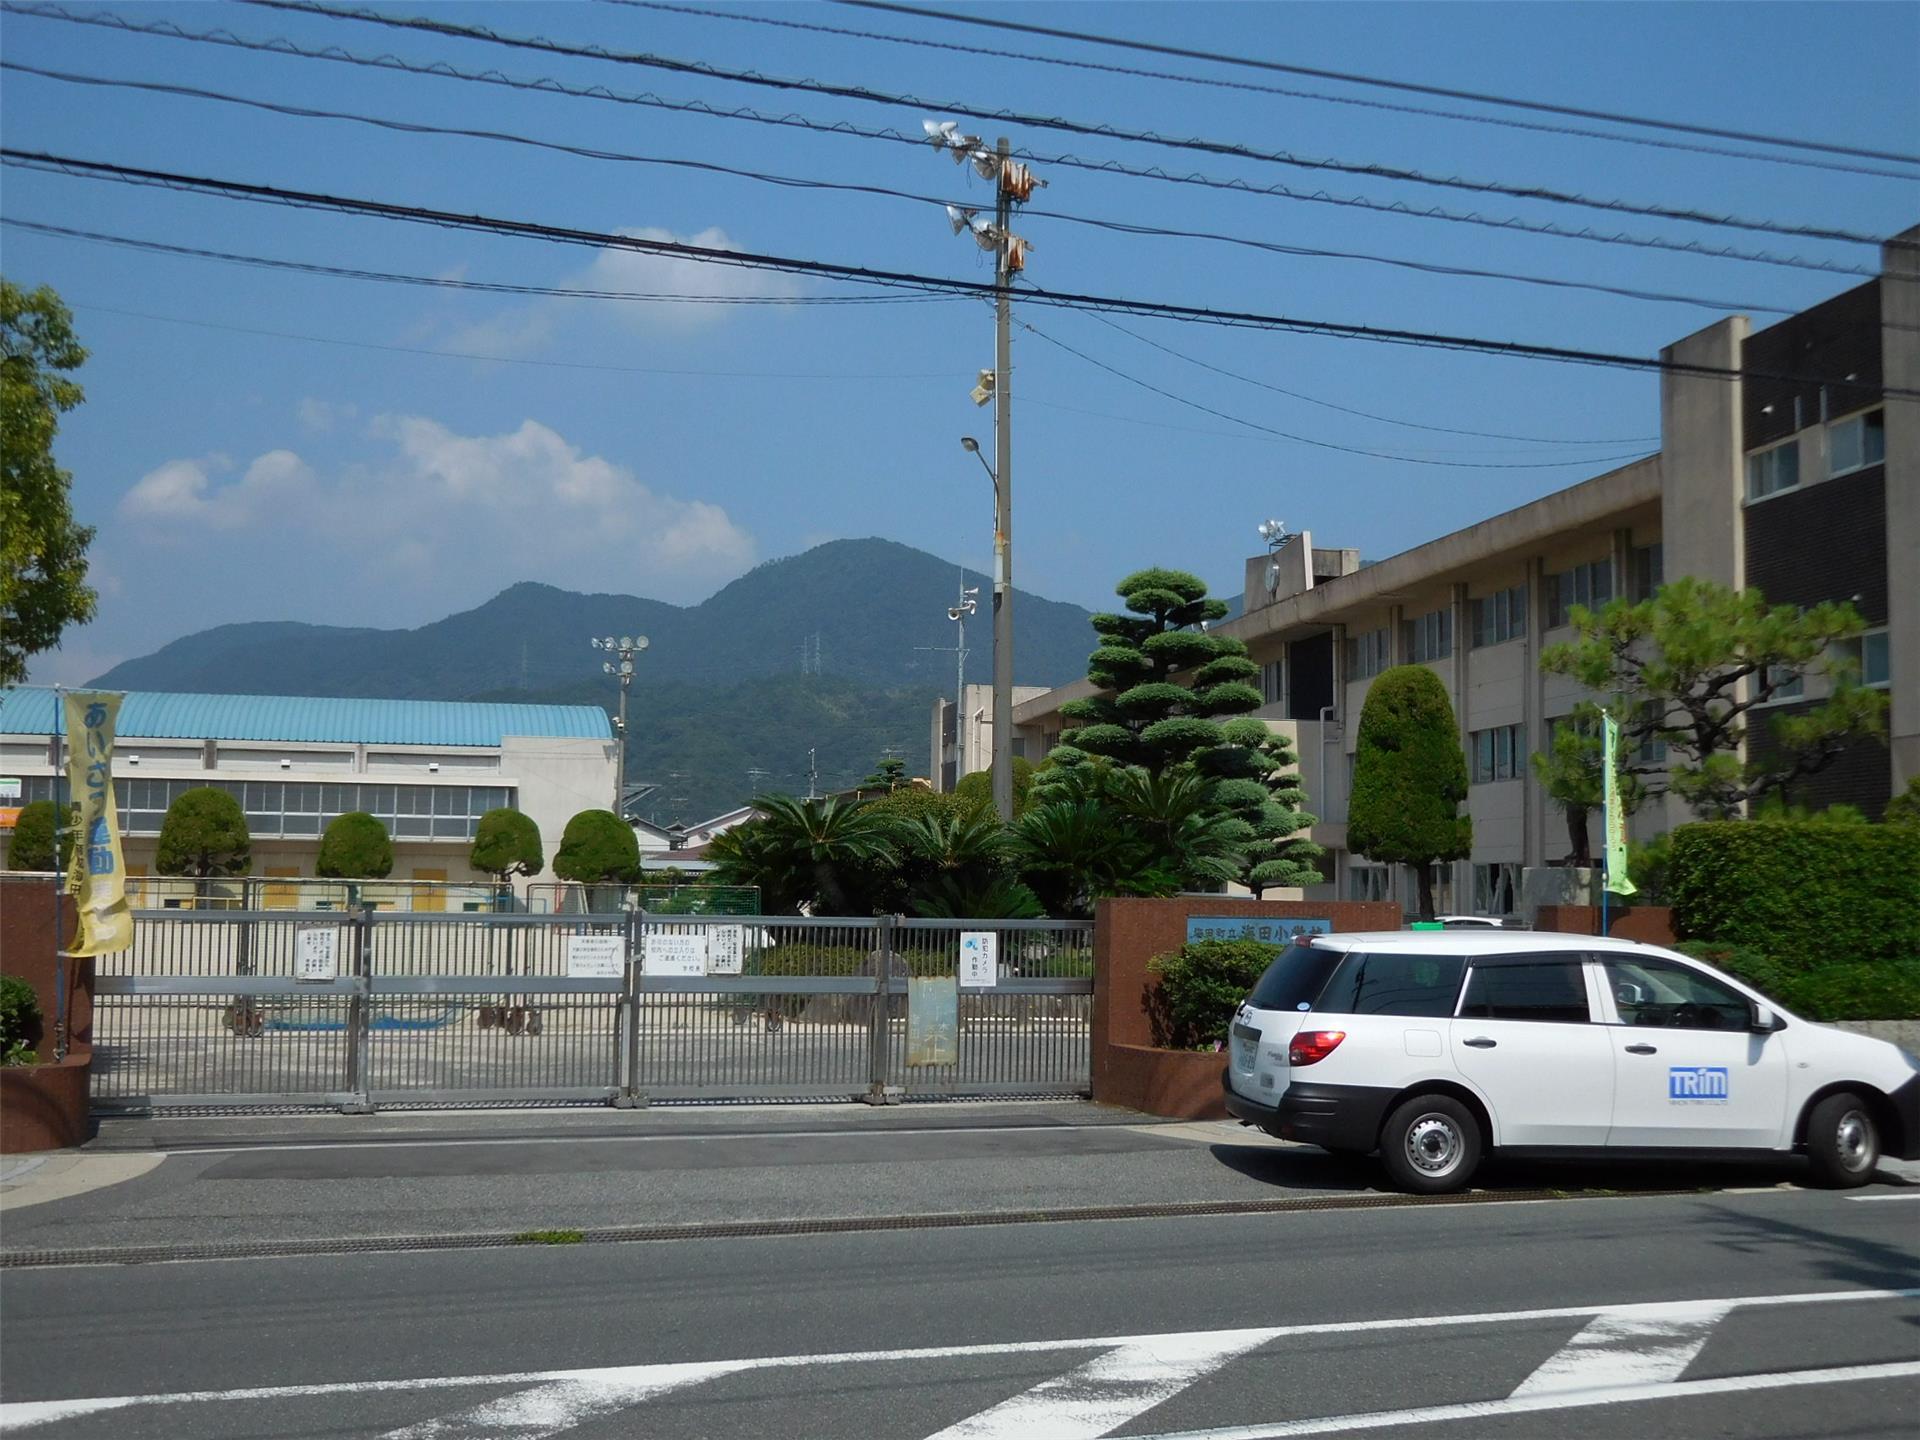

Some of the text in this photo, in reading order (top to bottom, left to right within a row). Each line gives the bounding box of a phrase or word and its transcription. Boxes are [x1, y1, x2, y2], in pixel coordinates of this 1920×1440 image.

[981, 937, 989, 974] 防犯カメラ
